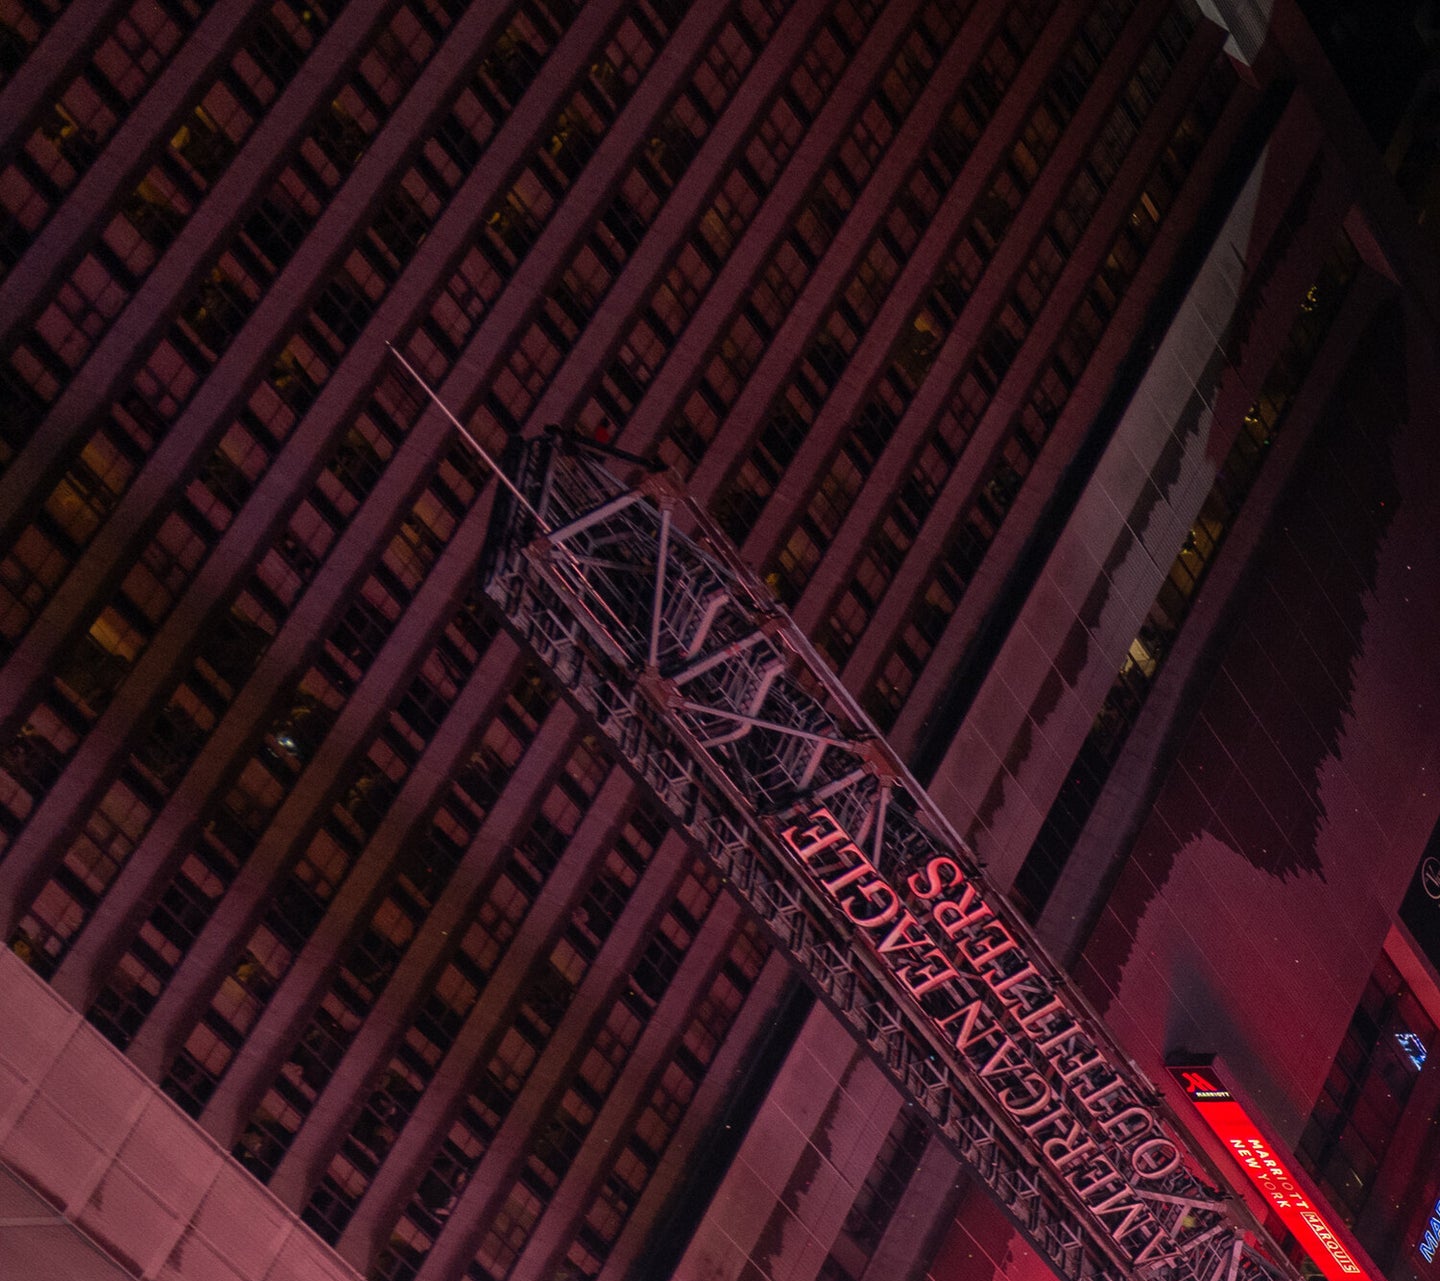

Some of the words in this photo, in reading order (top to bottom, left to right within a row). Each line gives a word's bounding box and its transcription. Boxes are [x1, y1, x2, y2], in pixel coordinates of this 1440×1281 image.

[782, 808, 961, 1001] EAGLE
[907, 855, 1182, 1181] OUTFITTERS
[935, 1001, 1187, 1268] AMERICAN
[1230, 1139, 1261, 1169] NEW
[1258, 1174, 1291, 1208] YORK
[1248, 1139, 1309, 1209] MARRIOTT
[1304, 1212, 1360, 1273] MARQUIS
